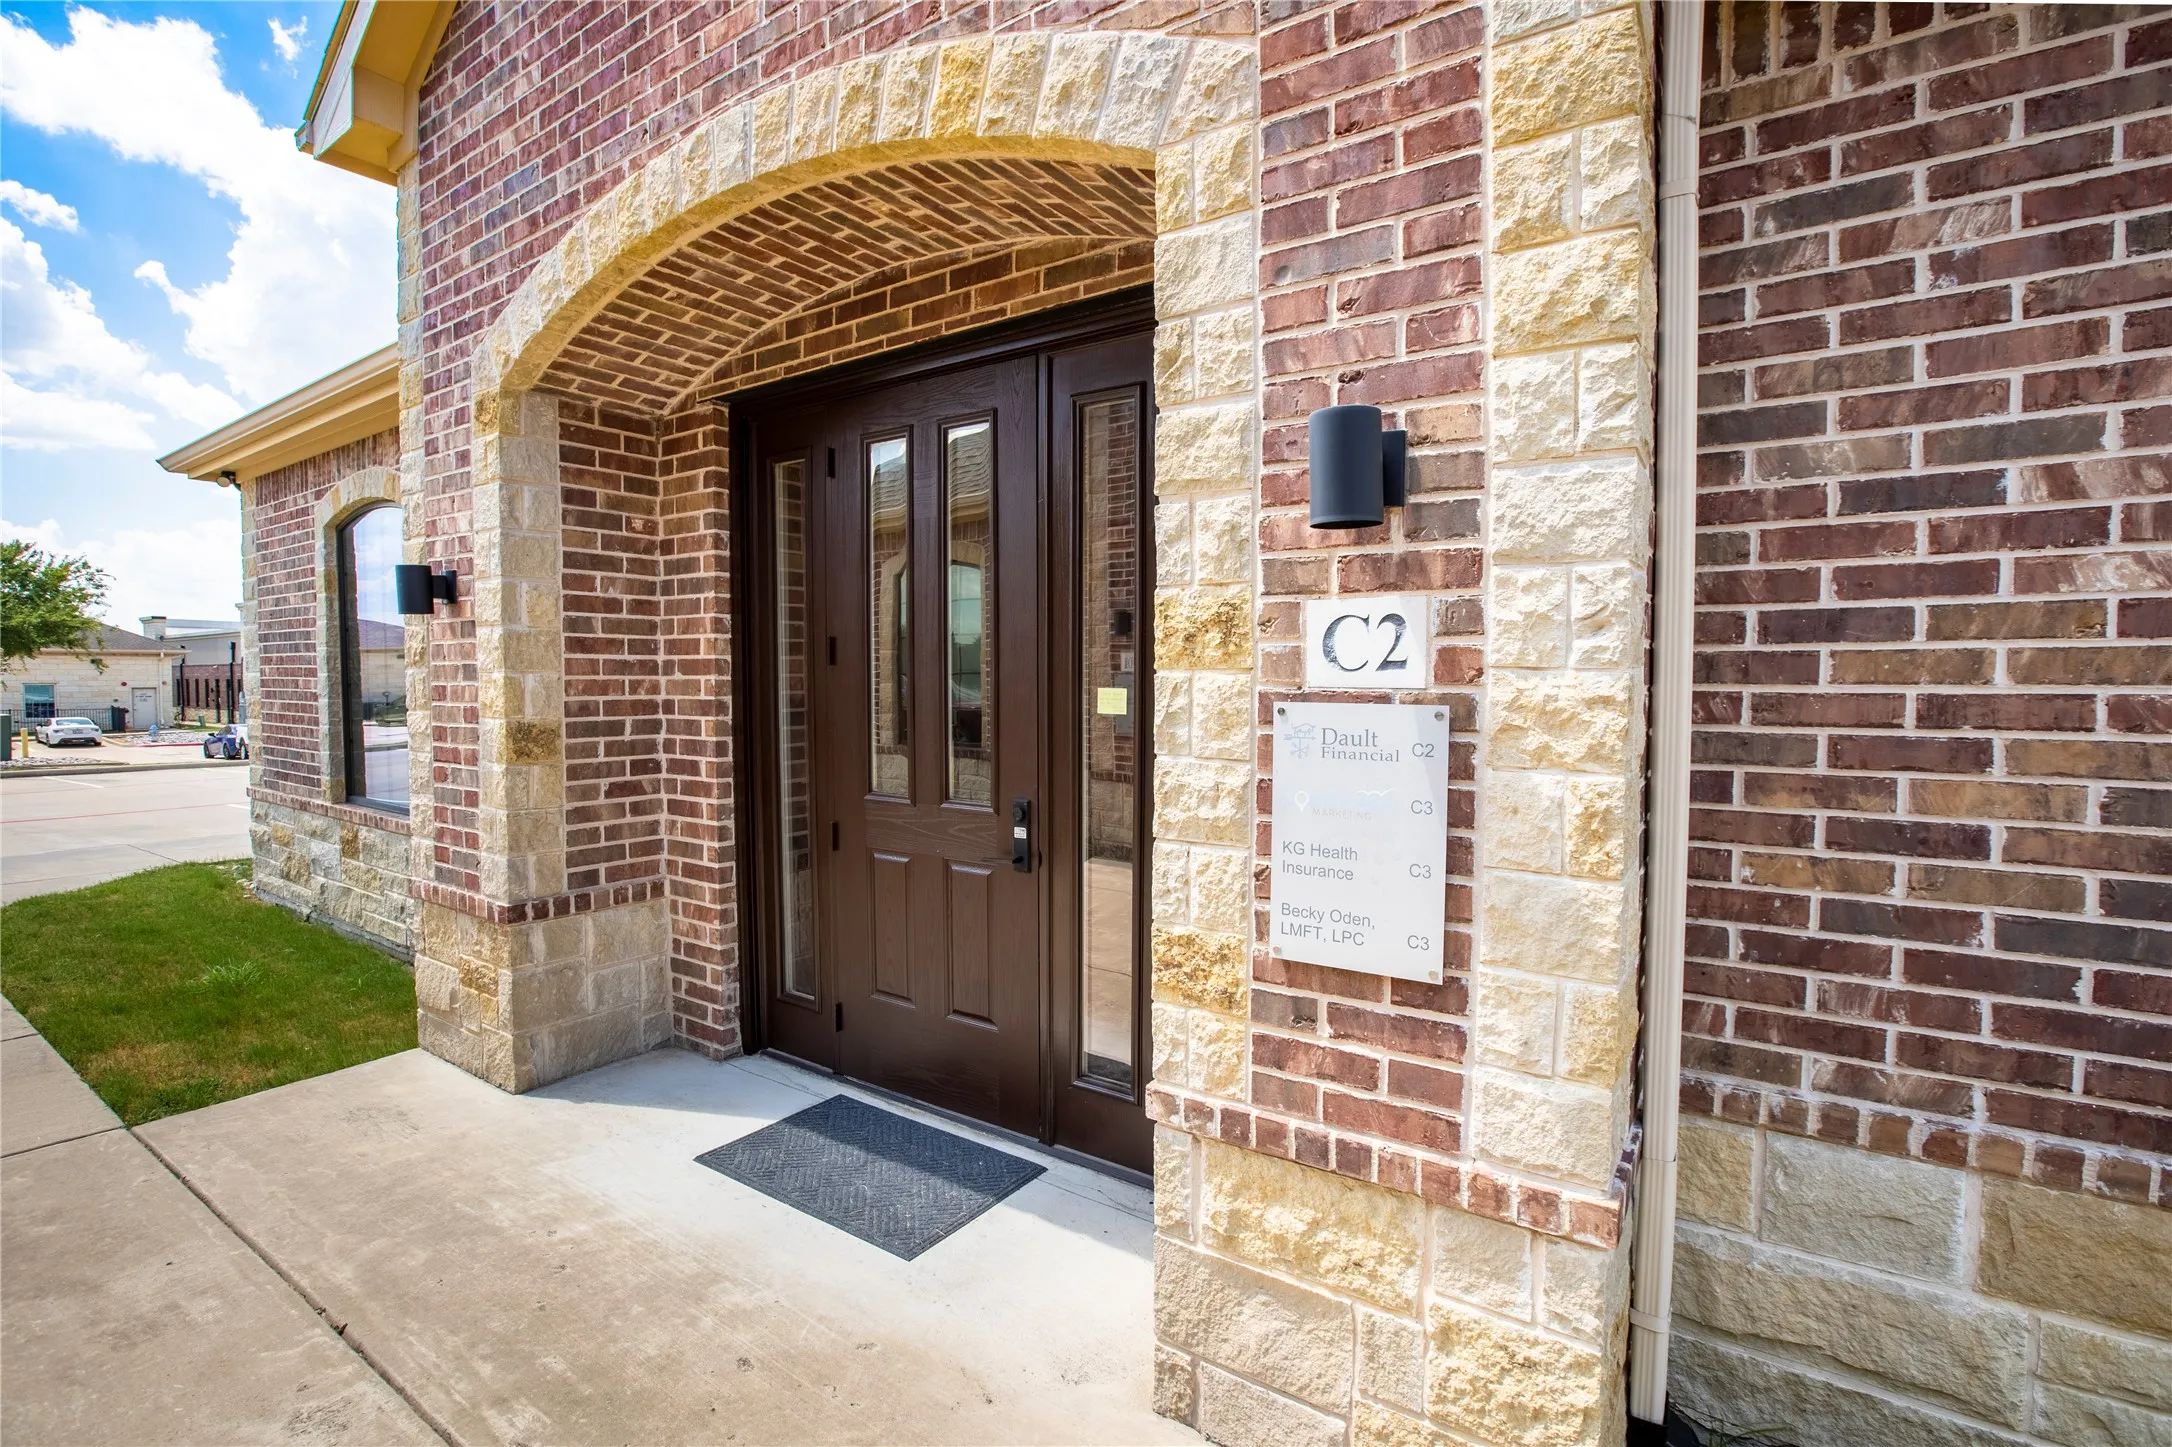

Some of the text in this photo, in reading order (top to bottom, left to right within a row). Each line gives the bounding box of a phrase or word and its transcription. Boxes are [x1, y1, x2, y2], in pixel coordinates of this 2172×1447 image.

[1322, 613, 1408, 672] C2
[1321, 727, 1378, 748] Dault
[1321, 746, 1400, 762] Financial
[1412, 743, 1435, 758] C2
[1312, 808, 1374, 821] MARKETING
[1410, 800, 1434, 815] C3
[1282, 841, 1358, 861] KG Health
[1282, 860, 1354, 880] Insurance
[1409, 864, 1432, 879] C3
[1281, 902, 1375, 930] Becky Oden,
[1281, 922, 1365, 946] LMFT, LPC
[1407, 935, 1430, 951] C3
